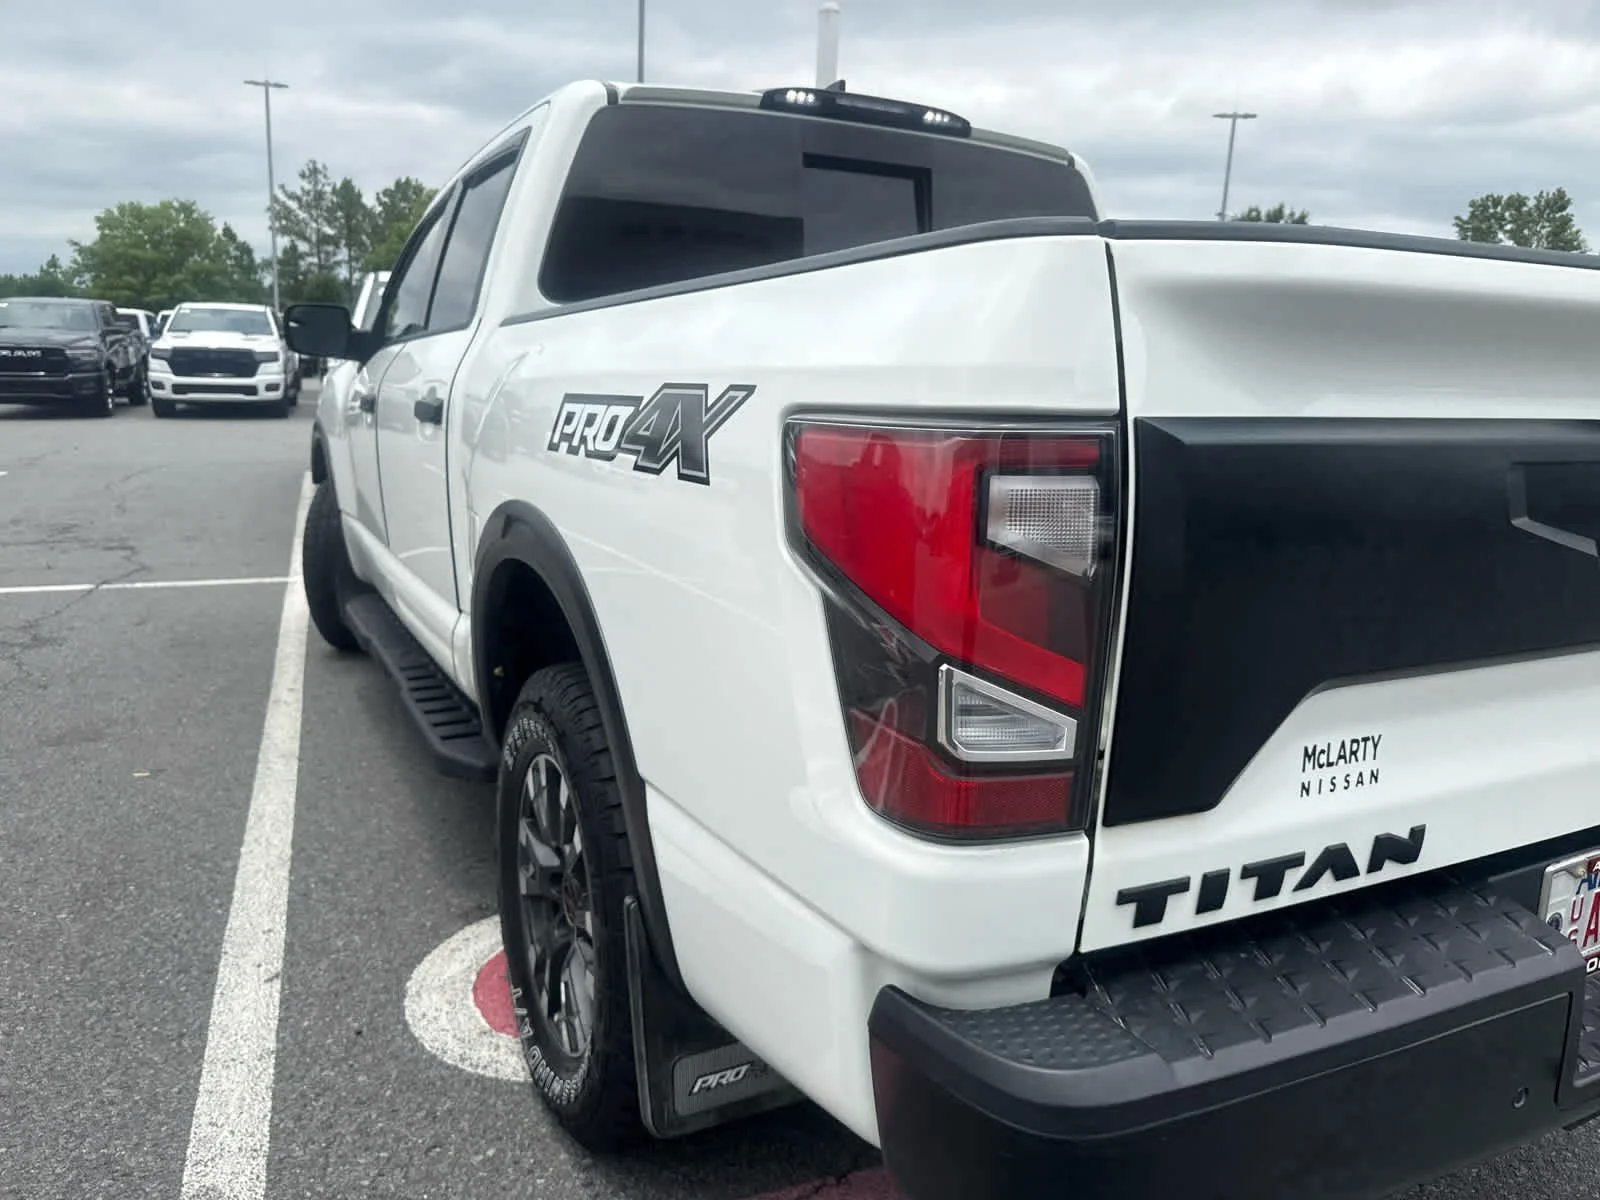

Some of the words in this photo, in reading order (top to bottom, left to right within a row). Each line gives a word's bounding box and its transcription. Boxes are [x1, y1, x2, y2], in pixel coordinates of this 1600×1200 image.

[1302, 733, 1382, 773] McLARTY
[1300, 767, 1379, 798] NISSAN
[1115, 824, 1427, 929] TITAN
